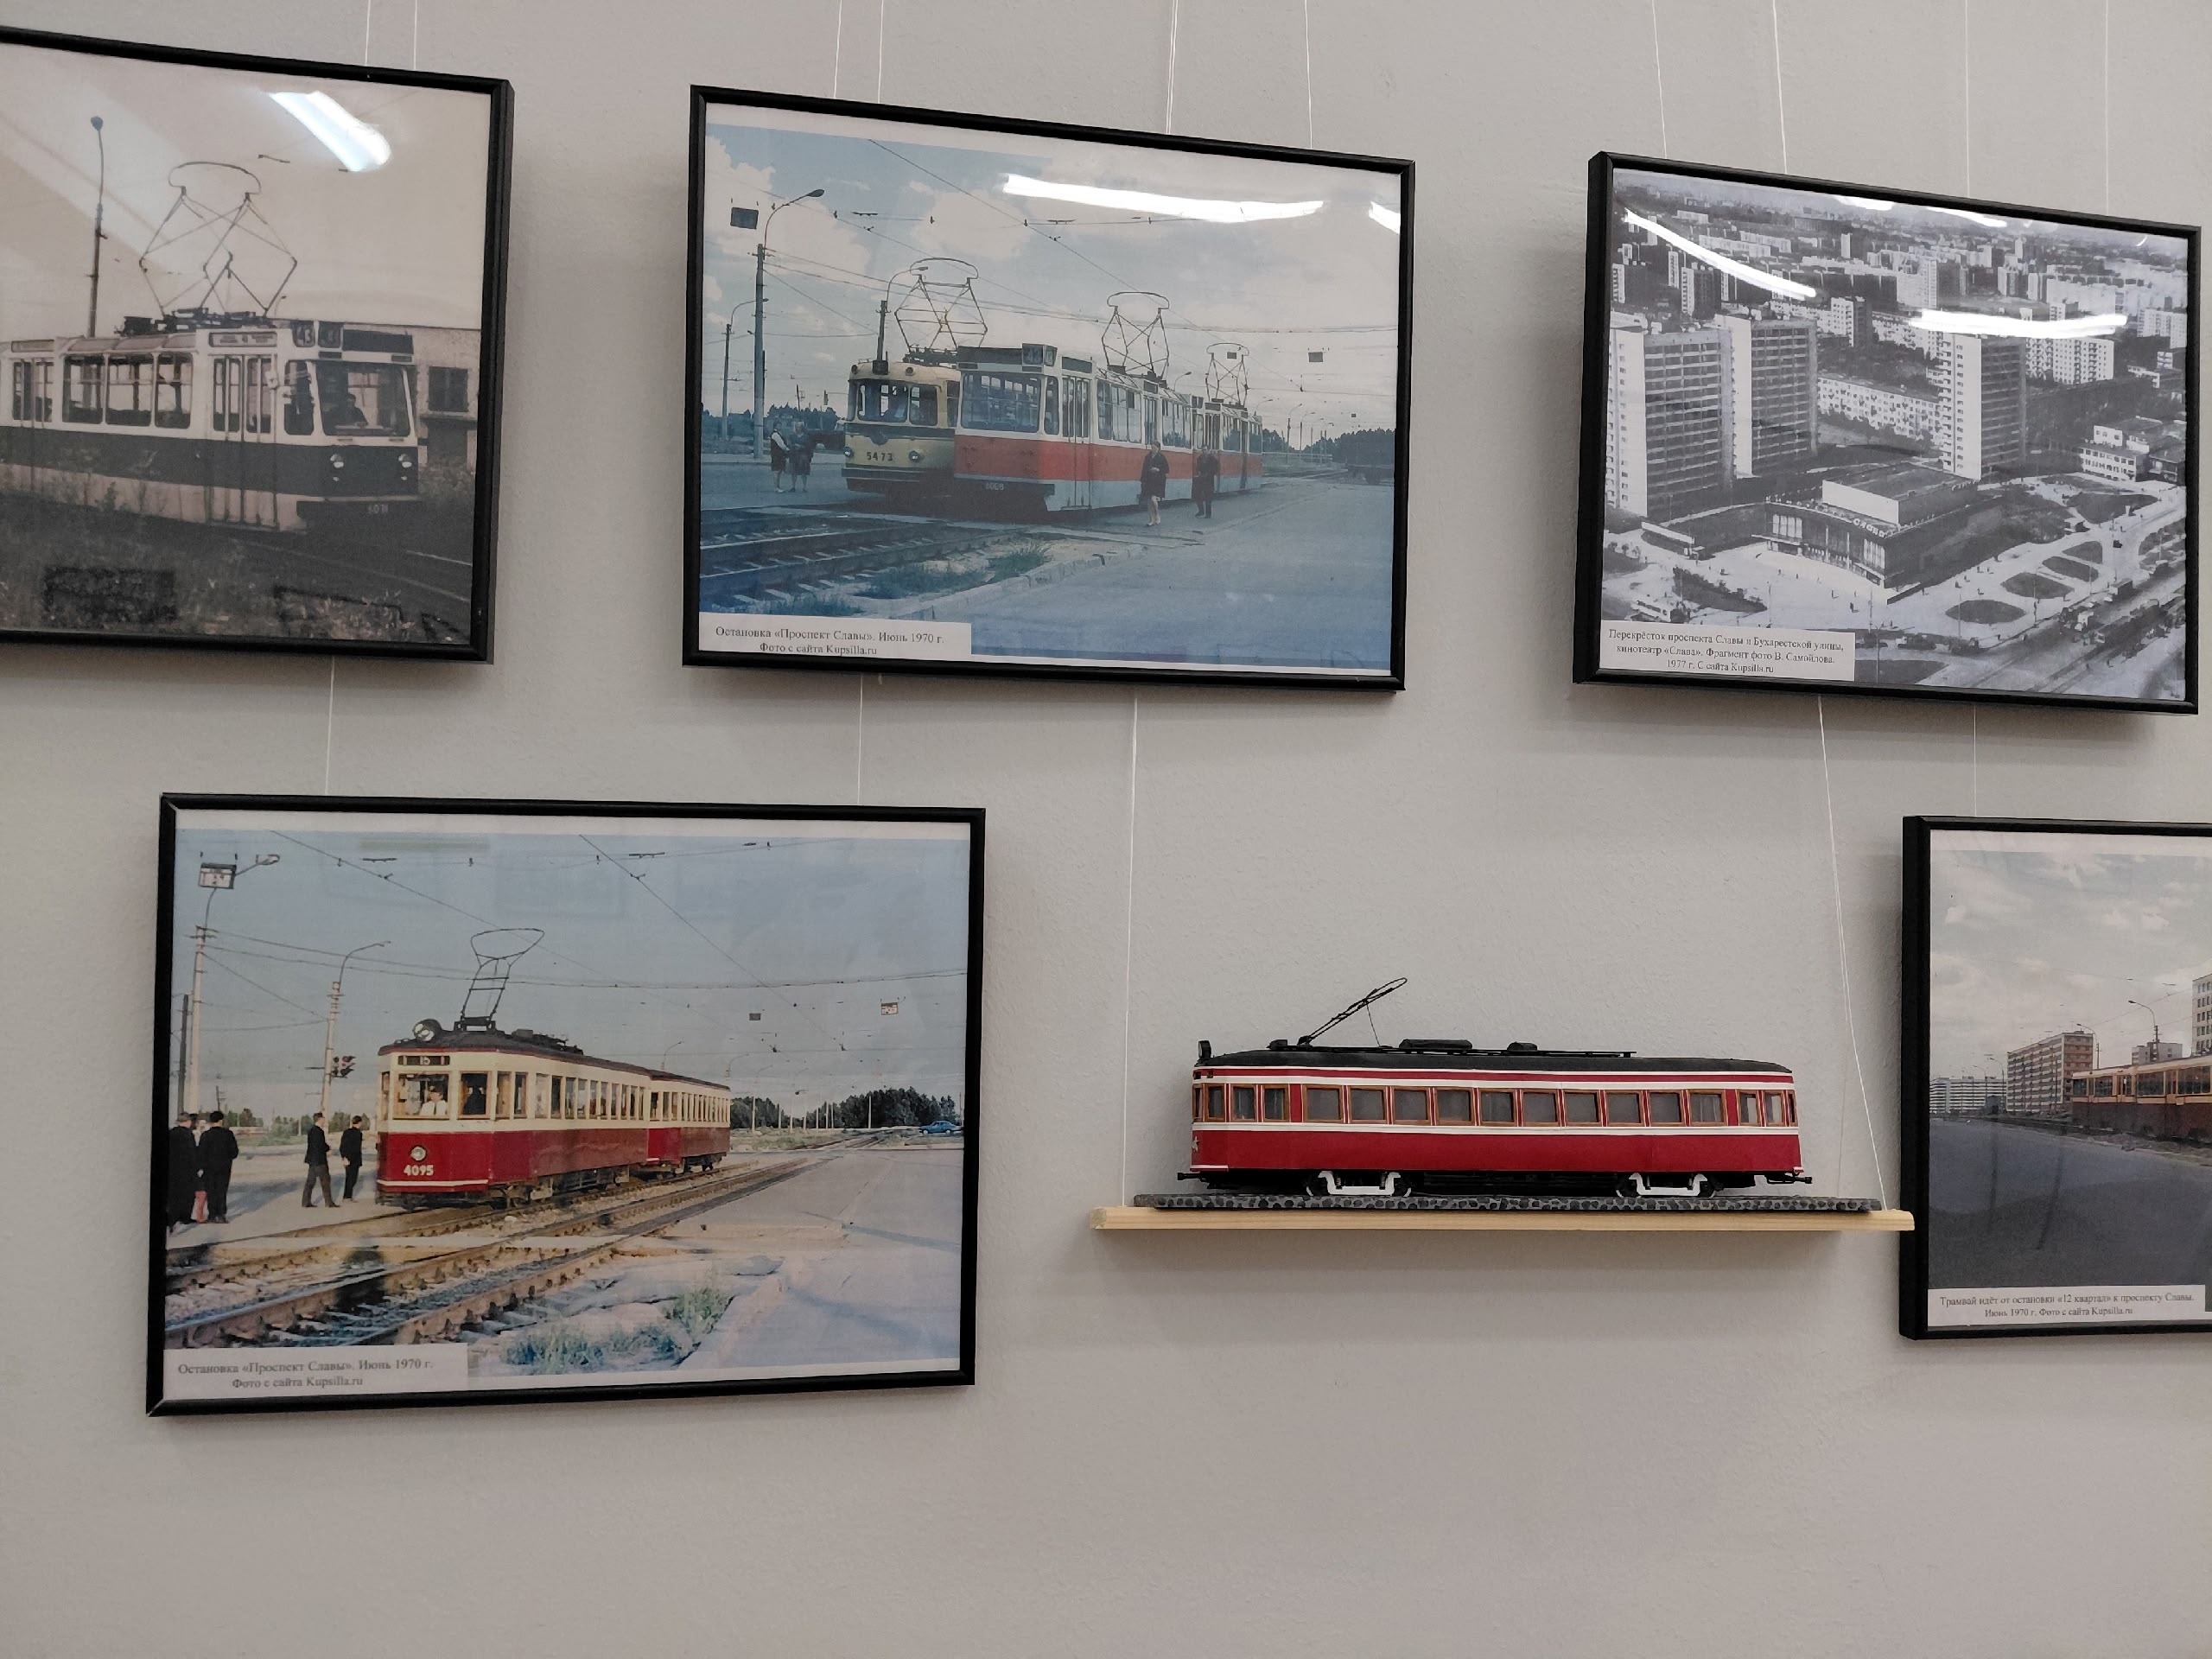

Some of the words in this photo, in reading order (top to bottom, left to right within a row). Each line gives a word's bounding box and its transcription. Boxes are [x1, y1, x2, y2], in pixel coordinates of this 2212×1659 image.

[866, 451, 893, 462] 5473
[715, 626, 772, 638] Остановка
[774, 628, 830, 640] «Проспект
[833, 630, 875, 641] Славы».
[879, 632, 908, 642] Июнь
[912, 632, 934, 643] 1970
[1608, 628, 1665, 641] Перекрёсток
[1668, 634, 1713, 643] проспекта
[1715, 634, 1744, 645] Славы
[1753, 637, 1812, 649] Бухарестской
[1813, 642, 1844, 652] улицы,
[760, 642, 786, 652] Фото
[796, 645, 823, 653] сайта
[826, 645, 877, 657] Kupsilla.ru
[1617, 645, 1662, 656] кинотеатр
[1663, 646, 1703, 657] «Слава».
[1706, 648, 1749, 659] Фрагмент
[1751, 651, 1772, 661] фото
[1774, 652, 1783, 661] В.
[1667, 659, 1687, 668] 1977
[1706, 663, 1729, 671] сайта
[1731, 663, 1774, 674] Kupsilla.ru
[404, 1165, 434, 1176] 4095
[1940, 1296, 1976, 1308] Трамвай
[1979, 1297, 1998, 1306] идёт
[2057, 1294, 2071, 1303] «12
[2075, 1295, 2112, 1305] квартал»
[2120, 1294, 2162, 1304] проспекту
[2165, 1292, 2194, 1301] Славы.
[1985, 1309, 2008, 1318] Июнь
[2011, 1308, 2029, 1317] 1970
[2038, 1308, 2061, 1317] Фото
[2091, 1306, 2133, 1317] Kupsilla.ru
[178, 1363, 239, 1374] Остановка
[242, 1362, 304, 1375] «Проспект
[359, 1359, 391, 1370] Июнь
[396, 1357, 422, 1370] 1970
[232, 1378, 261, 1389] Фото
[273, 1378, 302, 1388] сайта
[307, 1376, 363, 1389] Kupsilla.ru
